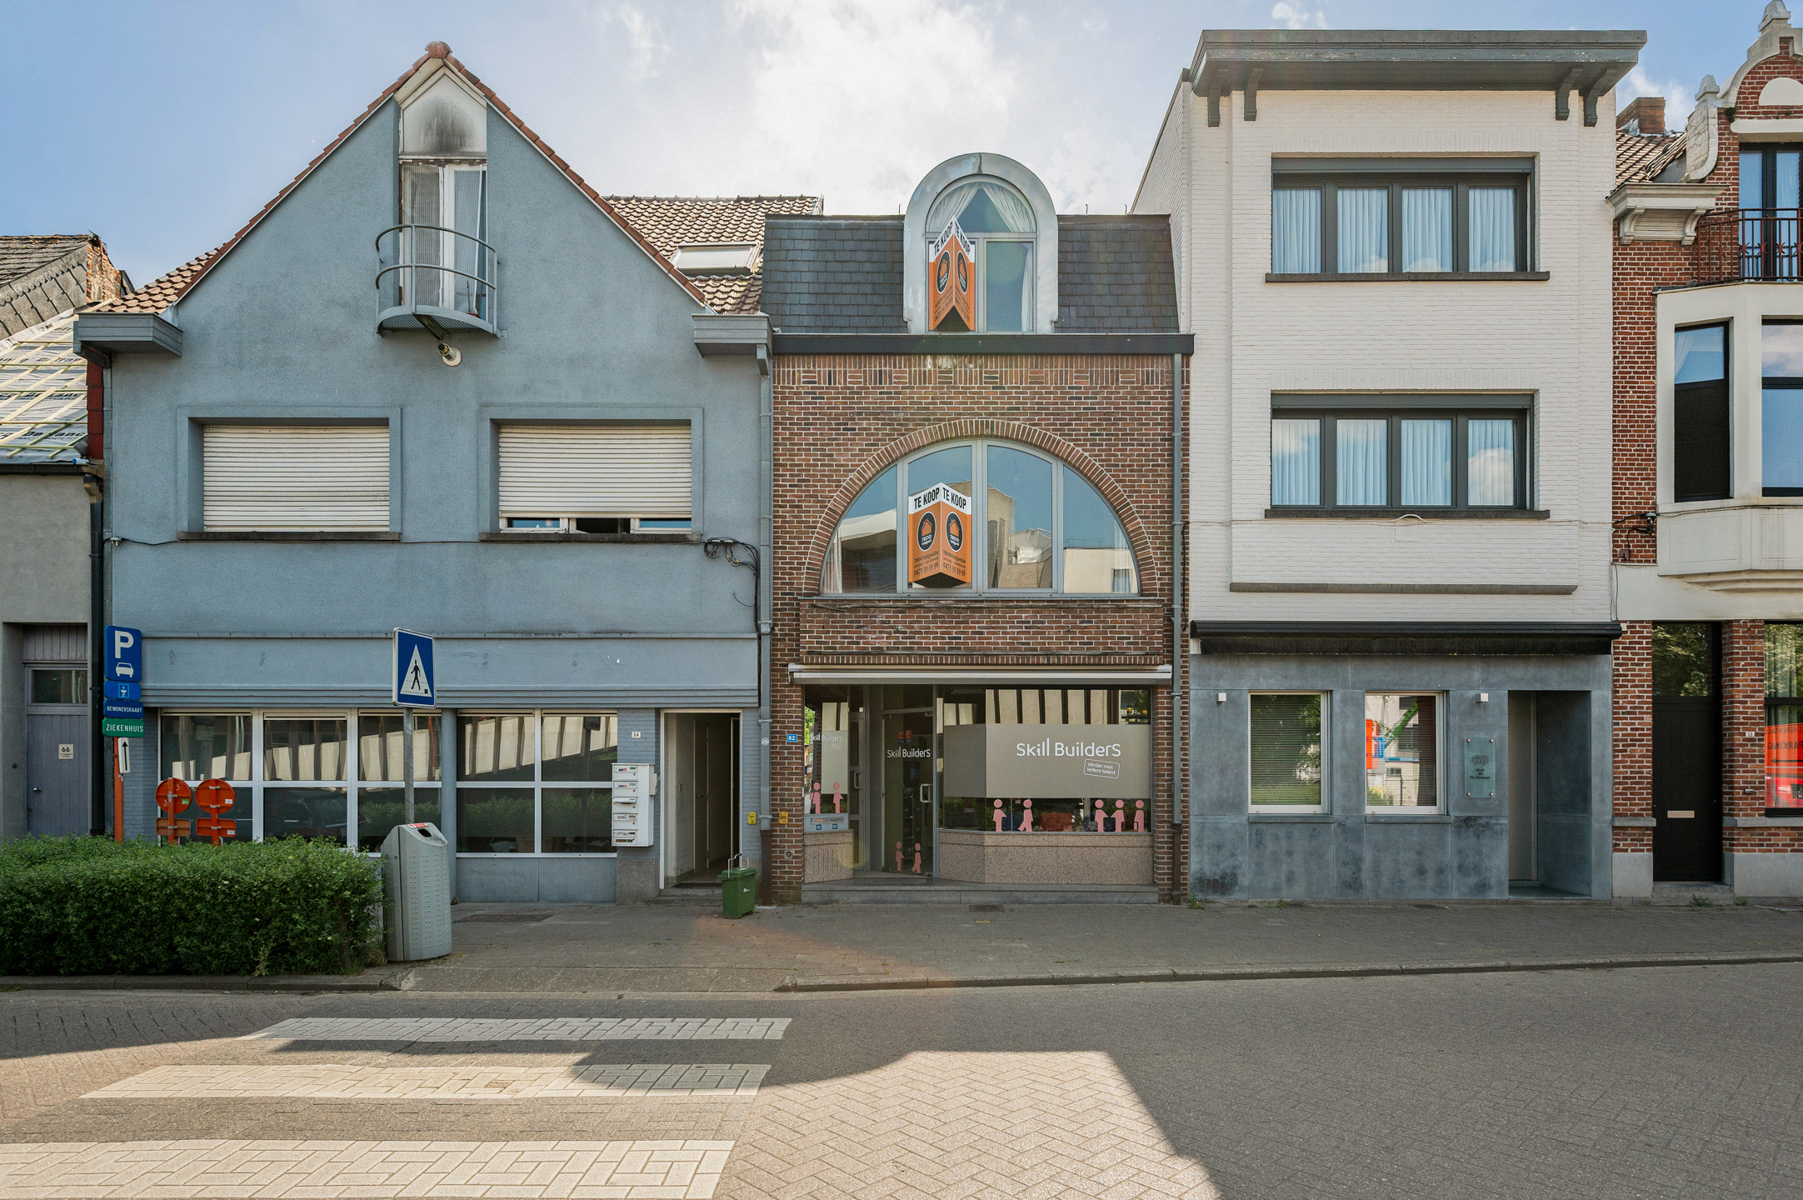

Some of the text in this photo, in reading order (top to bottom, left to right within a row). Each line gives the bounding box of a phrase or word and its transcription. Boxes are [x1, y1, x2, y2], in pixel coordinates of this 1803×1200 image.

[914, 487, 940, 510] TE KOOP
[943, 487, 967, 510] TE KOOP
[115, 630, 134, 659] P
[106, 705, 143, 713] BEWONERSKAART
[106, 723, 144, 733] ZIEKENHUIS
[887, 746, 901, 758] Skill
[1016, 737, 1050, 757] Skill
[1472, 755, 1489, 765] 60
